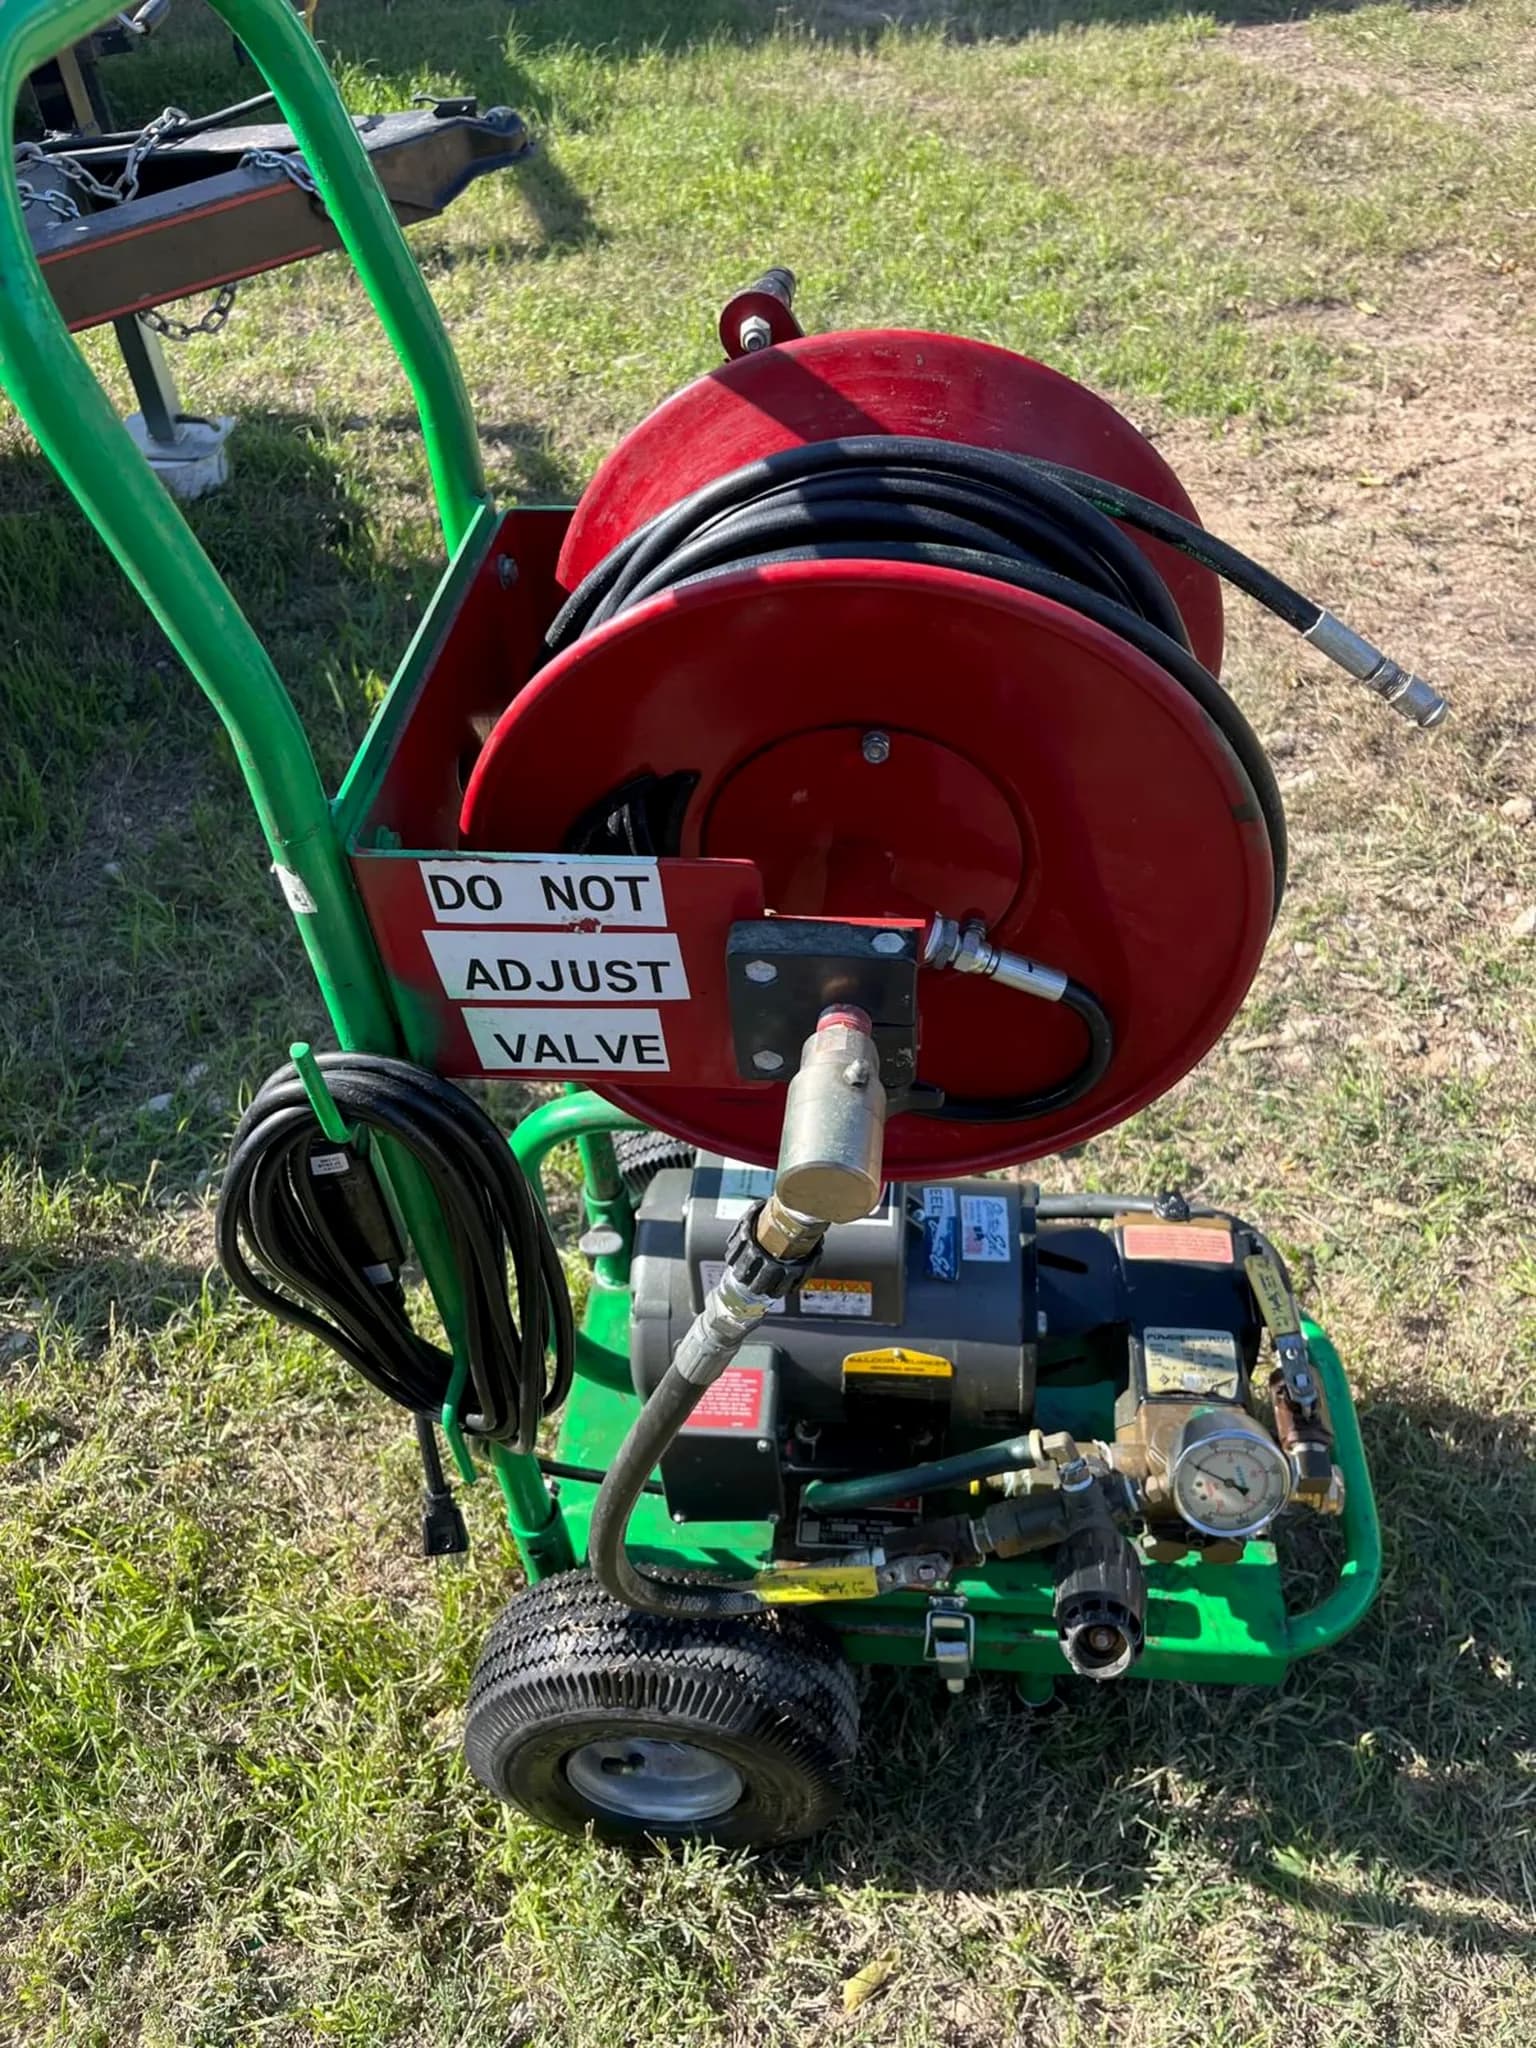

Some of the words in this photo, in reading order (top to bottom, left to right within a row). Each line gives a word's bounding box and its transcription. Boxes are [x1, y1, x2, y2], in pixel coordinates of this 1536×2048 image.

[428, 875, 503, 911] DO
[540, 875, 650, 911] NOT
[465, 958, 671, 994] ADJUST
[493, 1033, 665, 1064] VALVE
